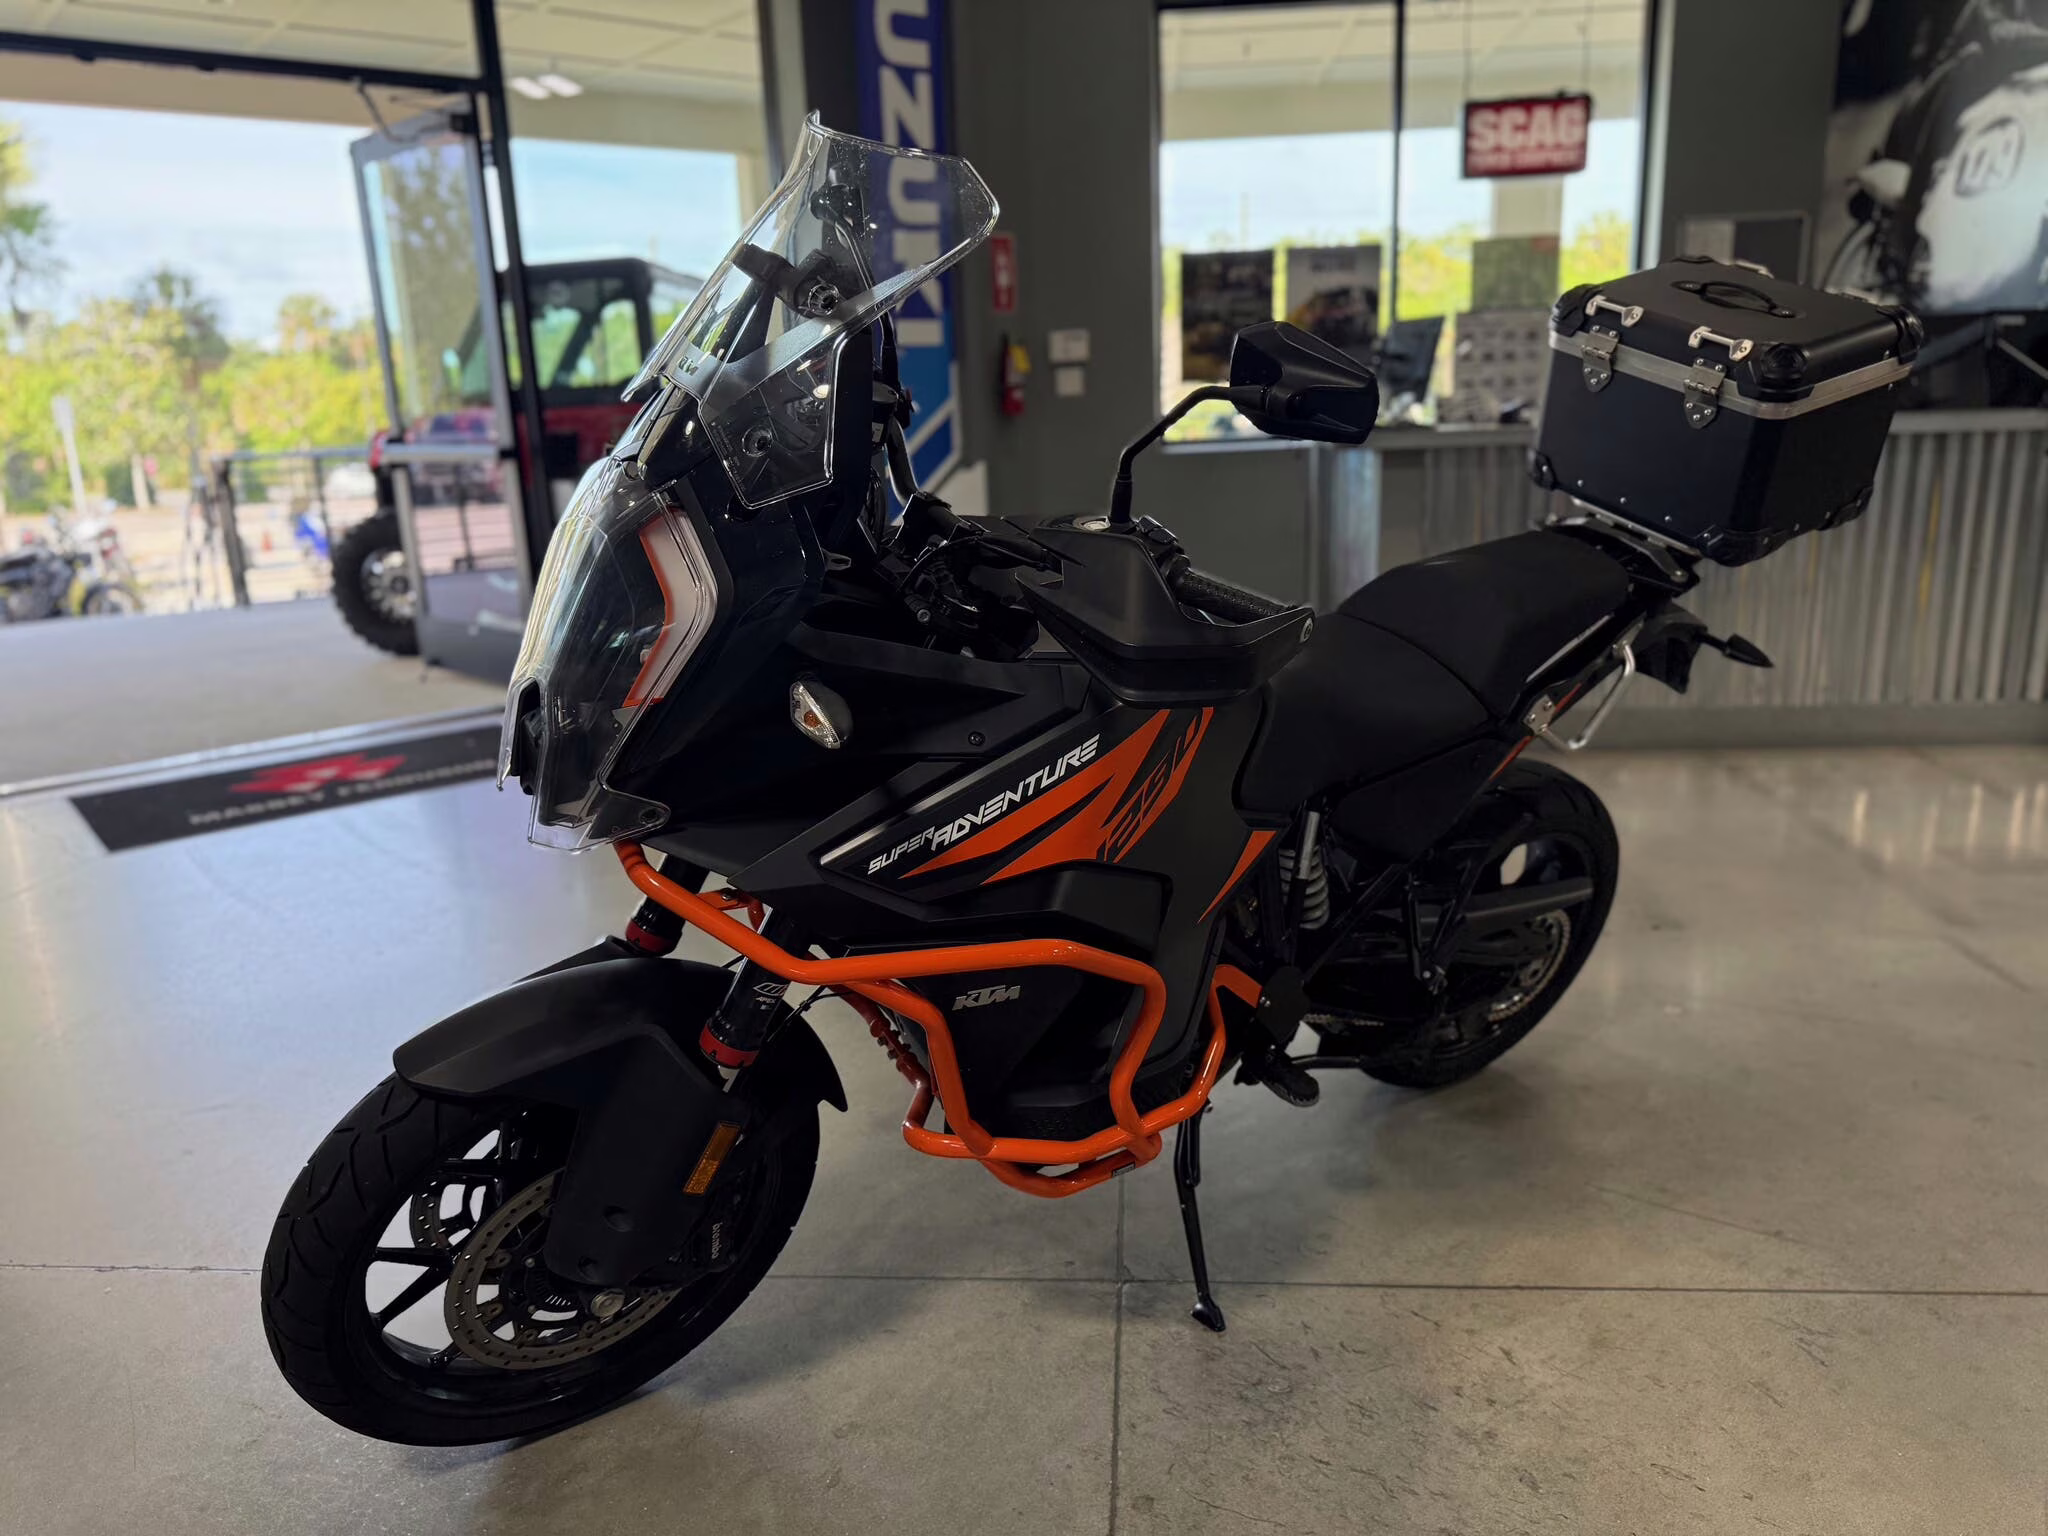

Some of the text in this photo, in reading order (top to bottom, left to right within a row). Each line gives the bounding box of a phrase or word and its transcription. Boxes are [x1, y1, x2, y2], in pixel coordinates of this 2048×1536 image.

[1468, 103, 1585, 151] SCAG
[867, 733, 1101, 876] SUPER ADVENTURE
[951, 984, 1021, 1012] KTM
[711, 1221, 723, 1260] brembo
